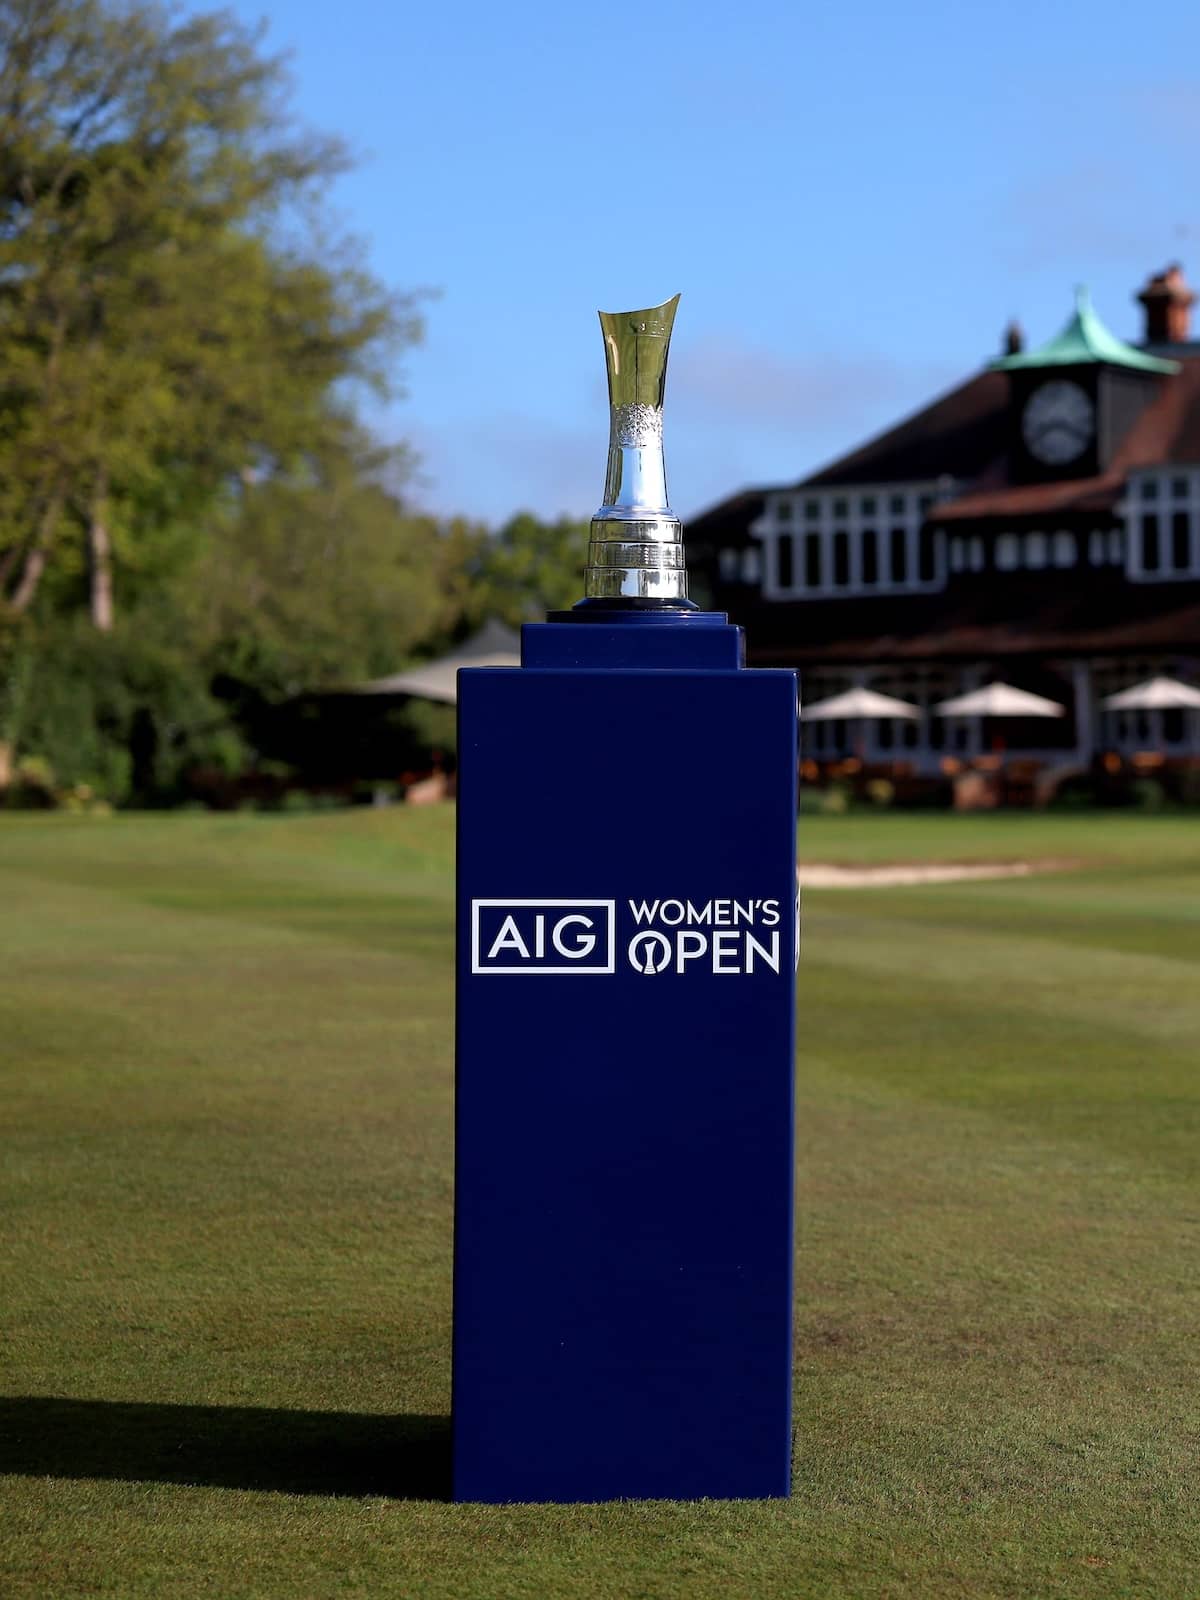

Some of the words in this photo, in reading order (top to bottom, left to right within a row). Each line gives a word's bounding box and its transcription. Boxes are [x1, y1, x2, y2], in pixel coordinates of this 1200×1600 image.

[628, 899, 780, 925] WOMEN'S
[487, 914, 596, 958] AIG
[628, 930, 780, 974] OPEN
